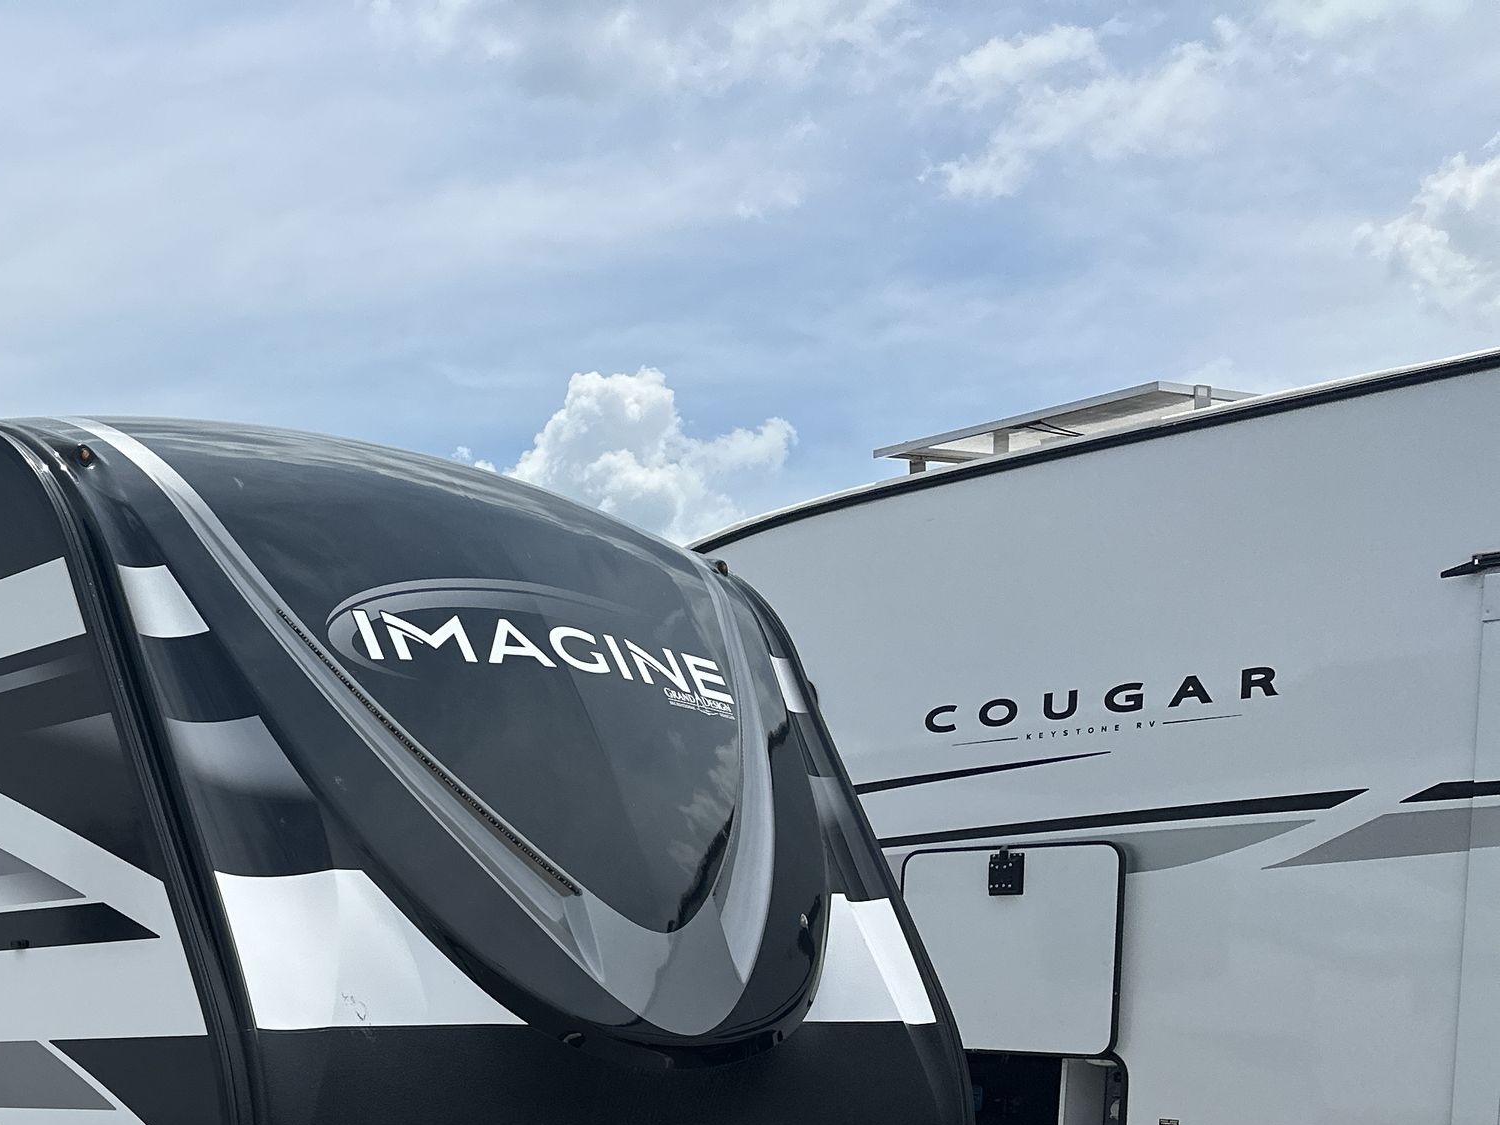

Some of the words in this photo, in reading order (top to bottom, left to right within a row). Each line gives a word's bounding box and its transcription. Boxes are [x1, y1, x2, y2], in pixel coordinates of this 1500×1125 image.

[352, 609, 734, 704] IMAGINE
[924, 666, 1279, 733] COUGAR
[1026, 724, 1120, 740] KEYSTONE
[1136, 720, 1155, 729] RV
